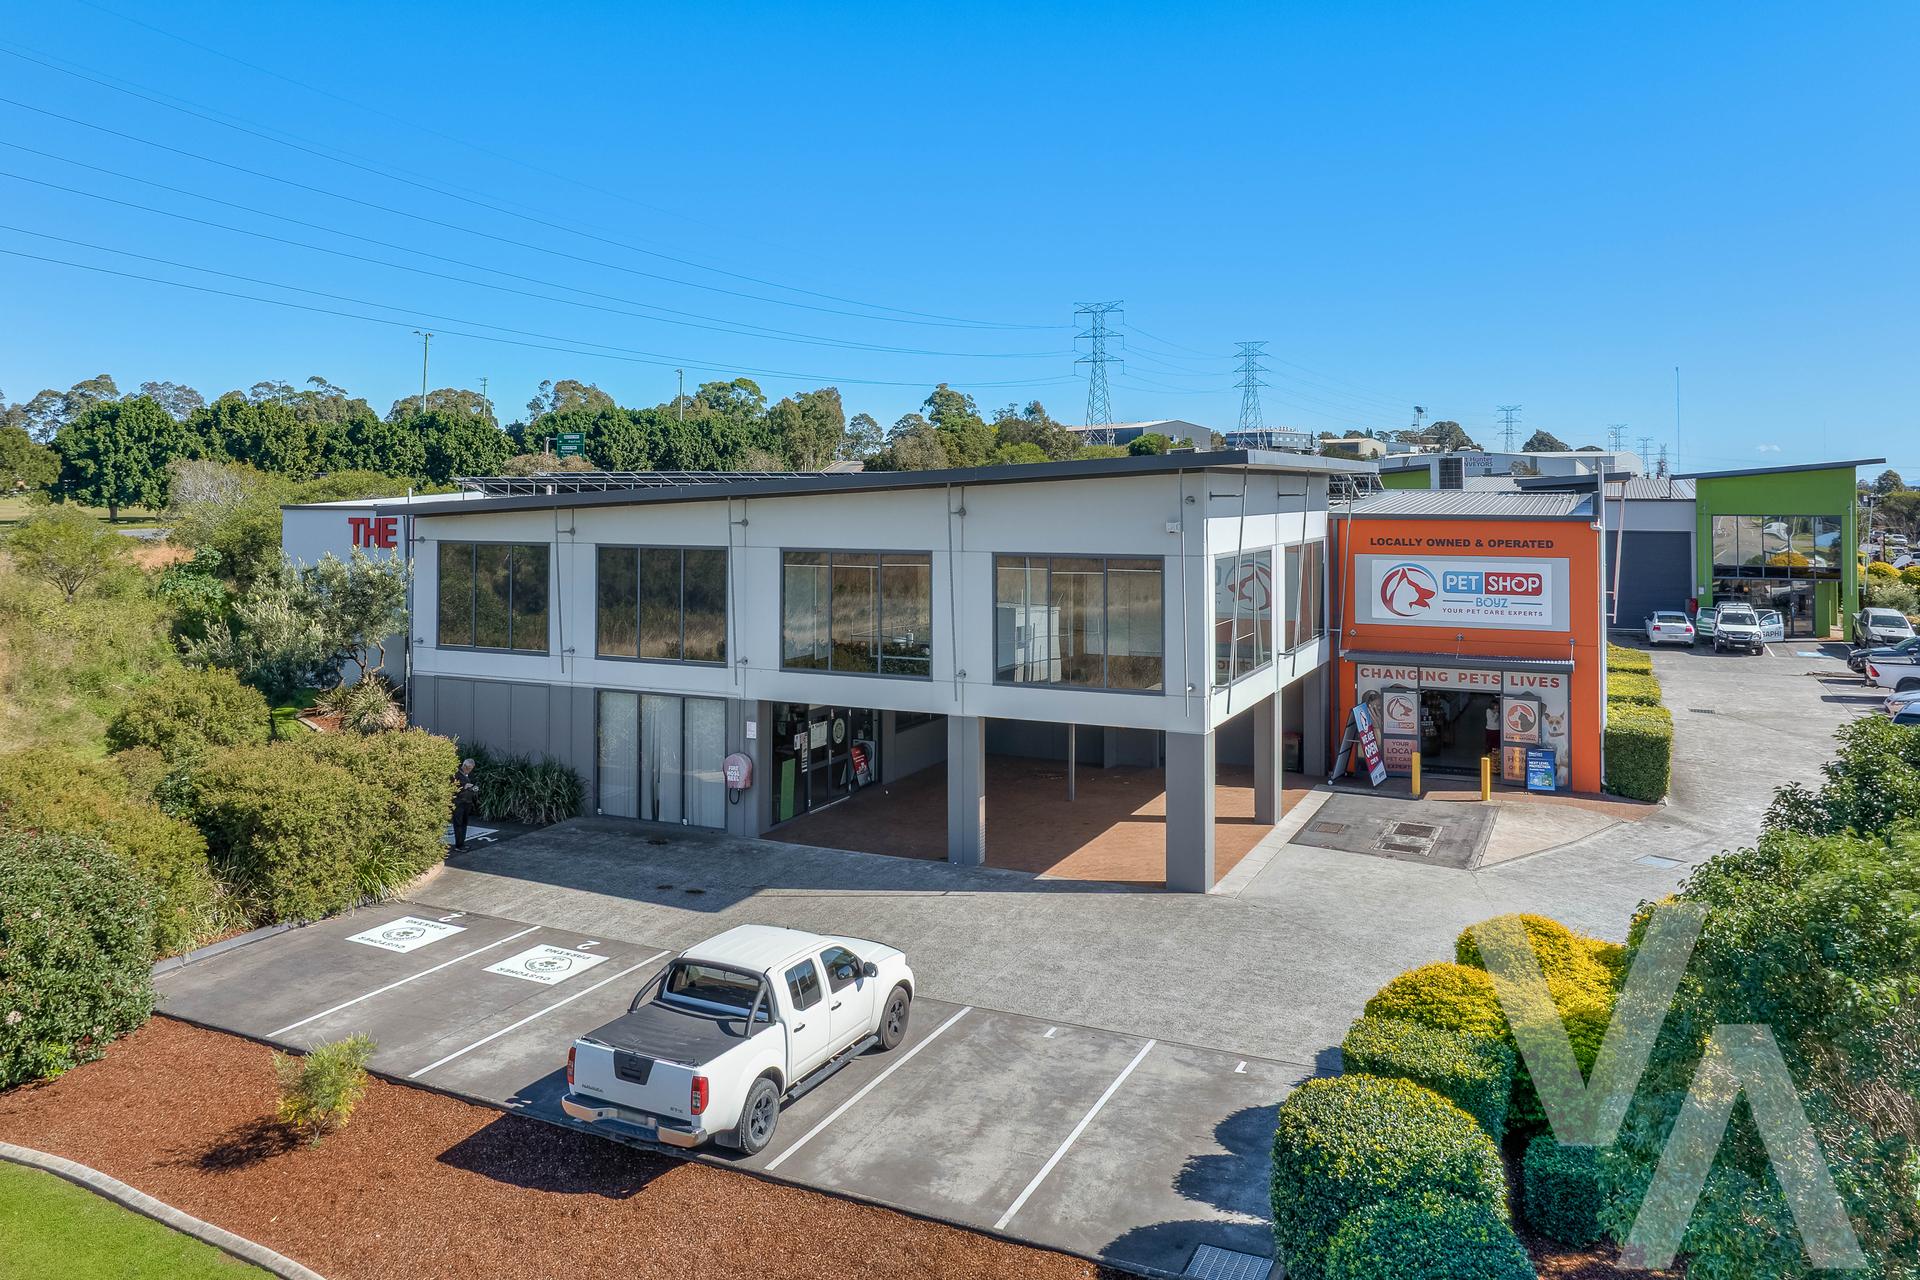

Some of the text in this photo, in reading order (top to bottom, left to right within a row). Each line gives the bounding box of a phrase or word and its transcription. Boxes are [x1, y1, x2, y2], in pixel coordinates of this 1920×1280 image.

[348, 517, 398, 549] THE
[1370, 537, 1554, 549] LOCALLY OWNED & OPERATED
[1446, 574, 1540, 593] PET SHOP
[1476, 597, 1508, 608] BOYZ
[1360, 668, 1560, 688] CHANGING PETS LIVES
[358, 936, 405, 949] CUSTOMER
[576, 940, 601, 950] 2
[545, 948, 591, 960] PARKING
[496, 967, 552, 981] CUSTOMER
